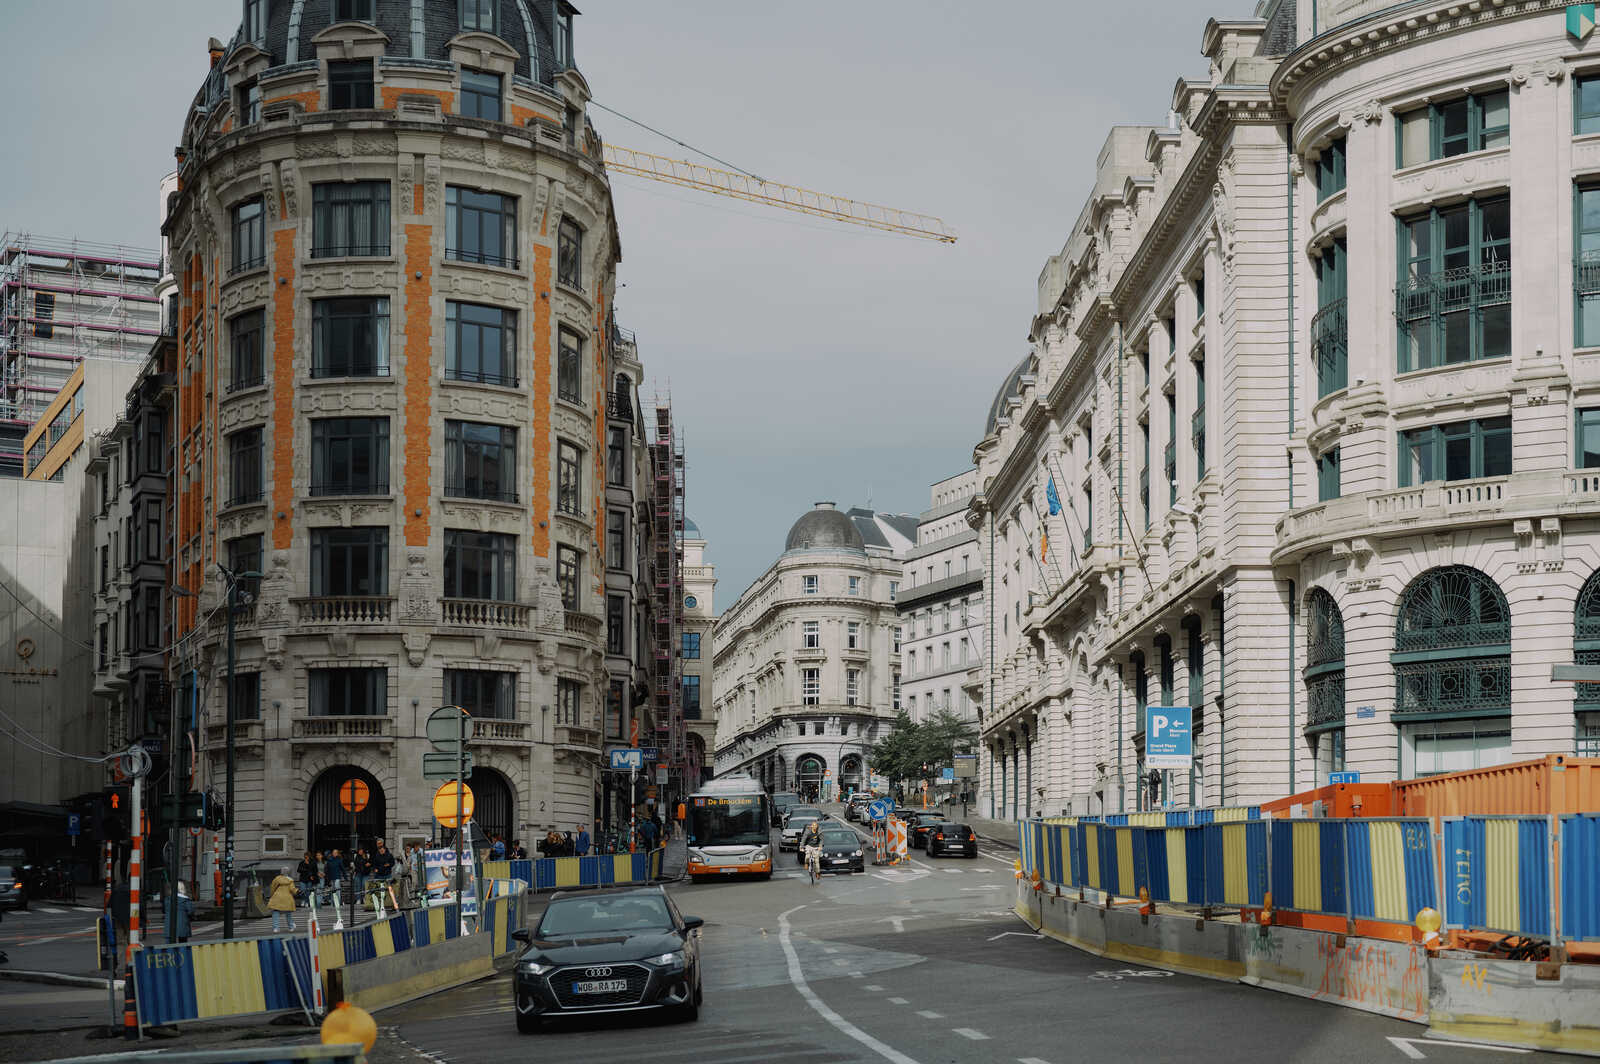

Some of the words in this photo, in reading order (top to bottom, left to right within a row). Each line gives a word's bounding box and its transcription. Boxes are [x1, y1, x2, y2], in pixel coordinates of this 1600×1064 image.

[1153, 716, 1168, 737] P
[540, 800, 546, 812] 2
[70, 816, 79, 828] P
